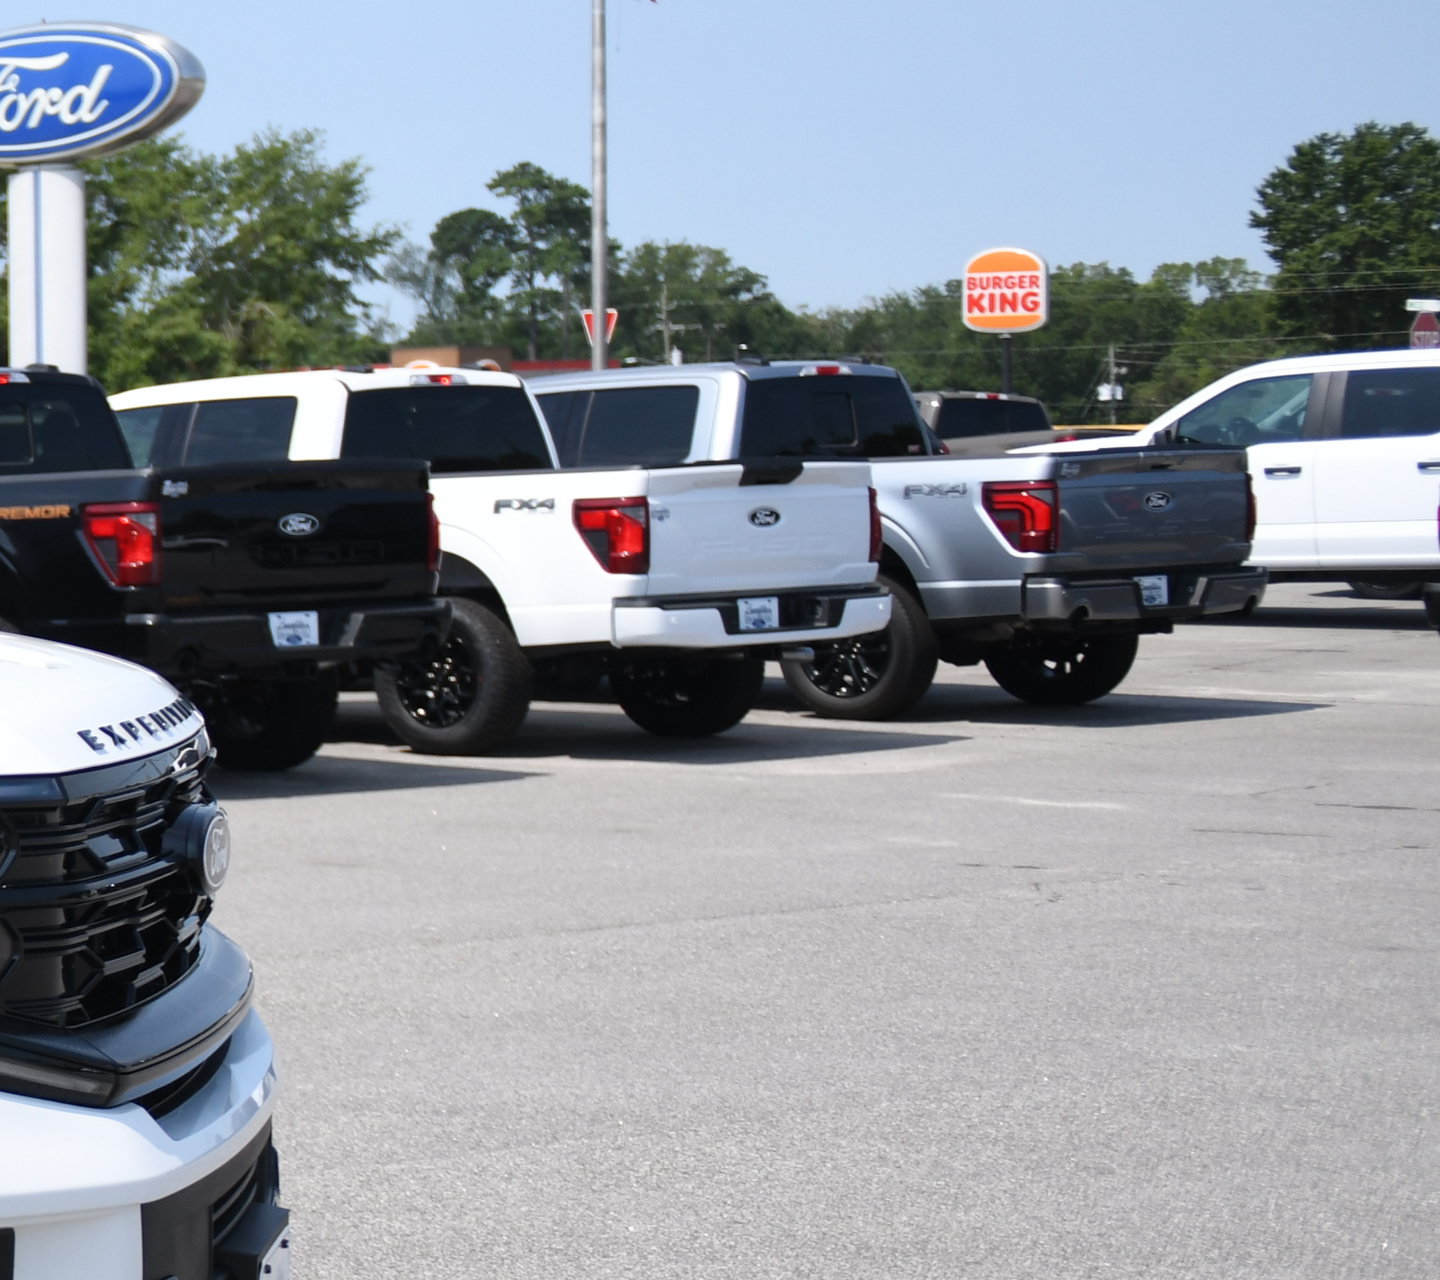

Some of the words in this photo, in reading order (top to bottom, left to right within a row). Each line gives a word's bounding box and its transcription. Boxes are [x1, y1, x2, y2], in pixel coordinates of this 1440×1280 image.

[966, 275, 1041, 291] BURGER
[966, 291, 1041, 314] KING
[903, 482, 968, 500] FX4
[493, 498, 555, 514] FX4
[76, 695, 197, 752] EXPEDITIO
